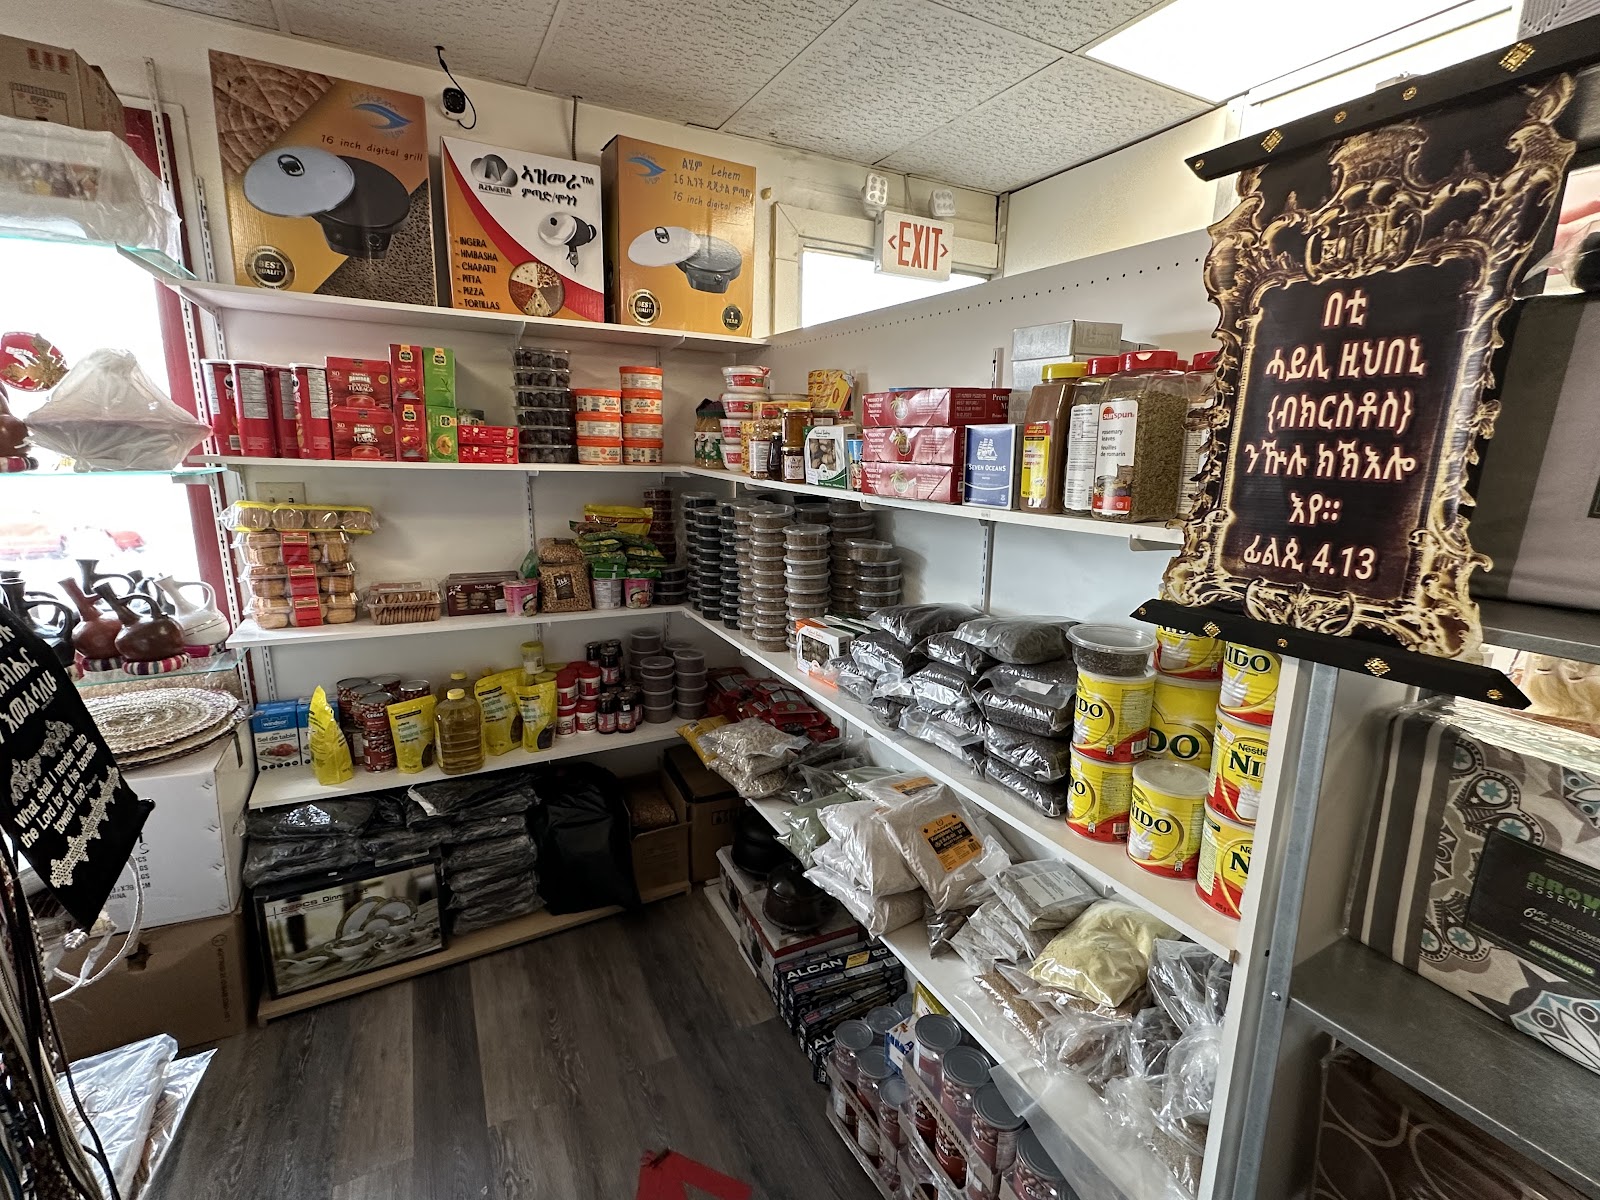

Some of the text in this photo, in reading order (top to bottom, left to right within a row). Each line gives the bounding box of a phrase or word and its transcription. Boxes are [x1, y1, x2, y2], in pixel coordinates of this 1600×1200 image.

[321, 135, 423, 161] 16 inch digital grill
[674, 173, 684, 185] 16
[711, 164, 741, 181] Lehem
[673, 191, 683, 202] 16
[687, 194, 703, 207] inch
[706, 197, 731, 211] digital
[459, 236, 488, 248] INGERA
[898, 220, 943, 271] EXIT
[258, 260, 282, 269] BEST
[463, 286, 485, 297] PIZZA
[464, 298, 500, 310] TORTILLAS
[638, 301, 653, 309] BEST
[1323, 289, 1367, 327] በቲ
[1103, 410, 1133, 420] sunspun
[1312, 543, 1376, 580] 4.13
[263, 719, 287, 727] windsor
[76, 741, 97, 772] benefits
[14, 733, 88, 829] What shall I render unto
[67, 768, 81, 785] his
[62, 778, 74, 797] all
[51, 792, 65, 810] for
[53, 782, 89, 835] toward me?
[36, 802, 57, 830] Lord
[20, 827, 40, 849] the
[1523, 907, 1537, 918] 6
[1551, 917, 1576, 932] DUVET
[1528, 939, 1595, 977] QUEEN/GRAND
[787, 958, 844, 980] ALCAN
